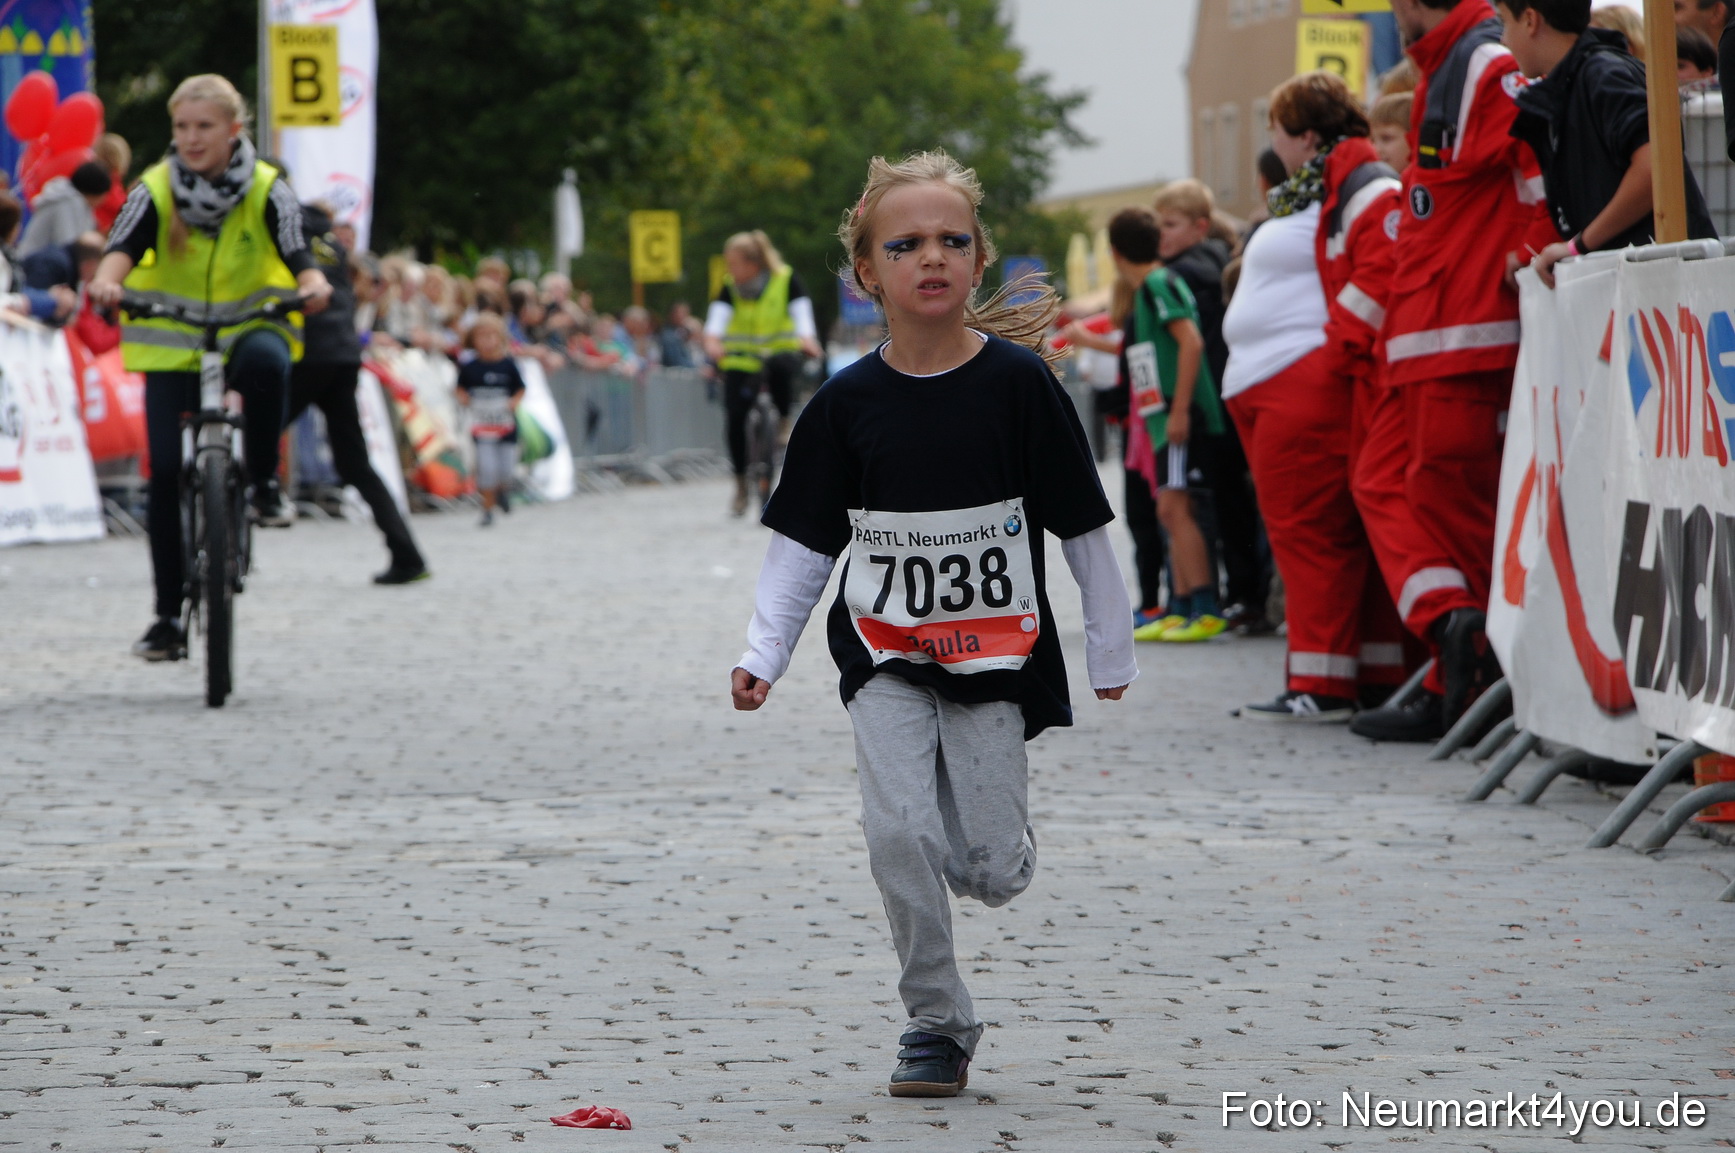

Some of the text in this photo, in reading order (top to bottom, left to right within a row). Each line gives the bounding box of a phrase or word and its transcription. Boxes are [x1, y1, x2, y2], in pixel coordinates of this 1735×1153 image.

[290, 55, 323, 104] B
[642, 230, 669, 264] C
[855, 524, 998, 547] PARTL Neumarkt
[868, 546, 1013, 618] 7038
[1019, 598, 1031, 611] W
